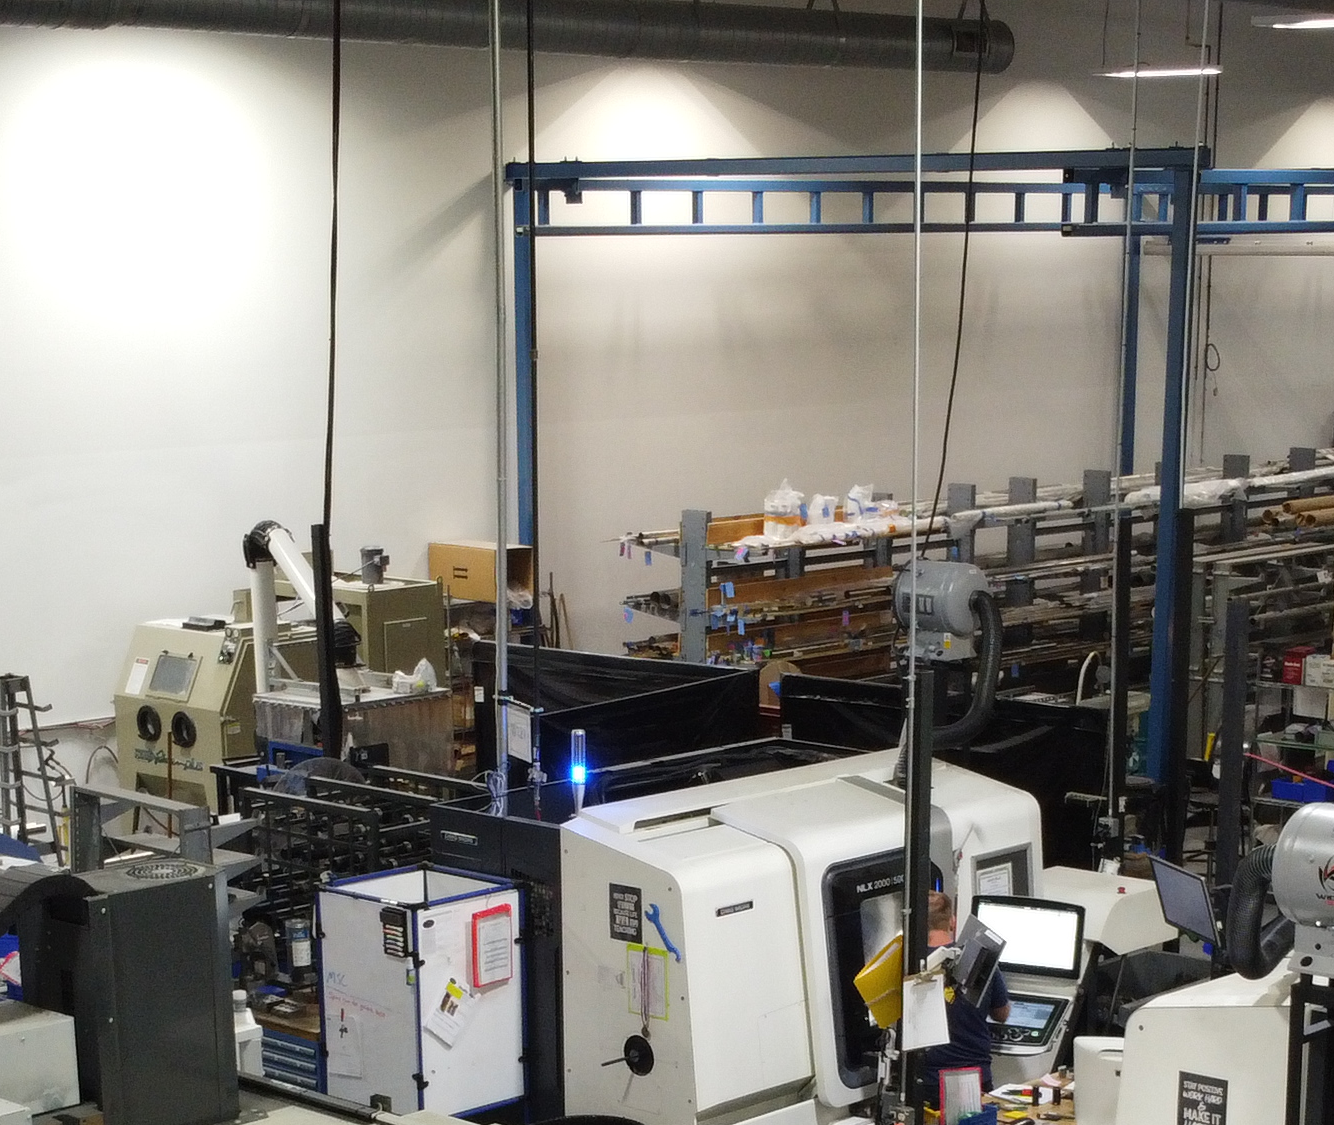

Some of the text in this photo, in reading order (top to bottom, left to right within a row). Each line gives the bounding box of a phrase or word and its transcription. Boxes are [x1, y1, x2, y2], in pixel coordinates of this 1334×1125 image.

[856, 881, 873, 893] NLX
[1182, 1090, 1223, 1105] WORK HARD
[1197, 1101, 1207, 1111] &
[1183, 1107, 1222, 1125] MAKE IT
